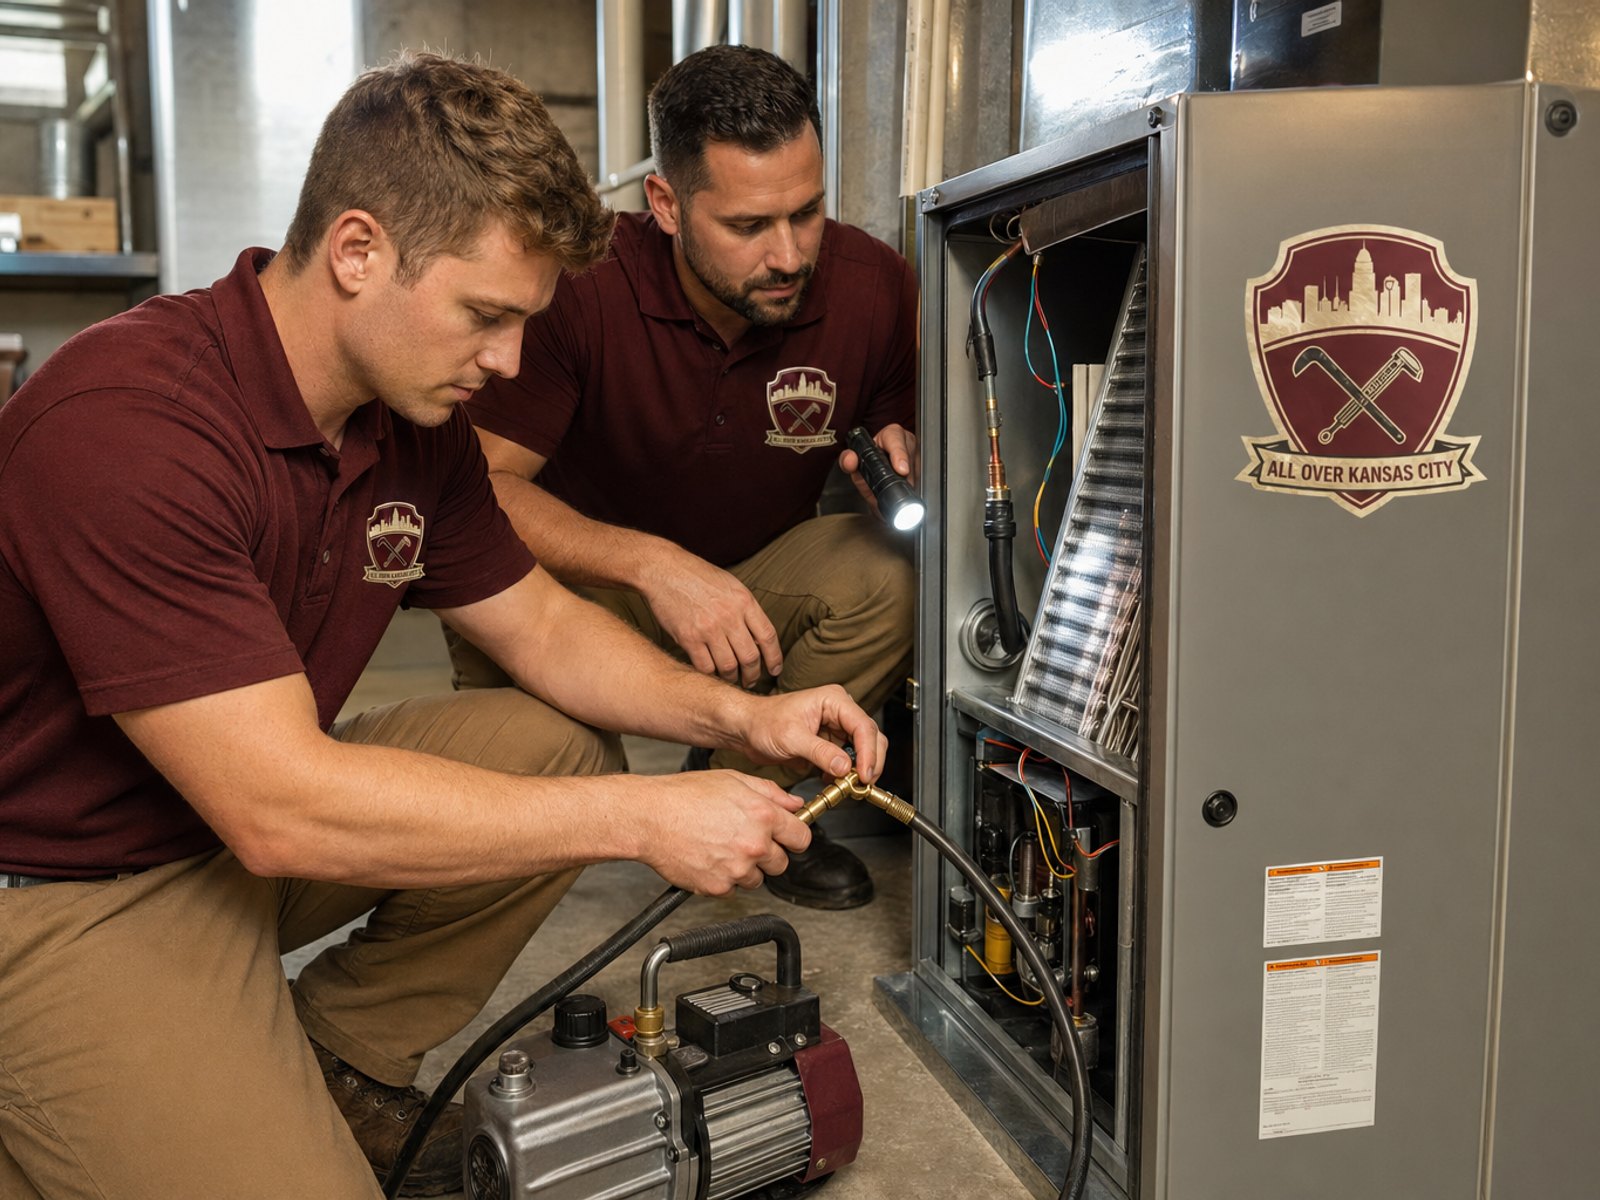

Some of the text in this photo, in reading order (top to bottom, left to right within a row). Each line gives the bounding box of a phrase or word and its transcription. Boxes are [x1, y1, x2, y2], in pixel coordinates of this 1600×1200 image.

[1267, 460, 1454, 483] ALL OVER KANSAS CITY
